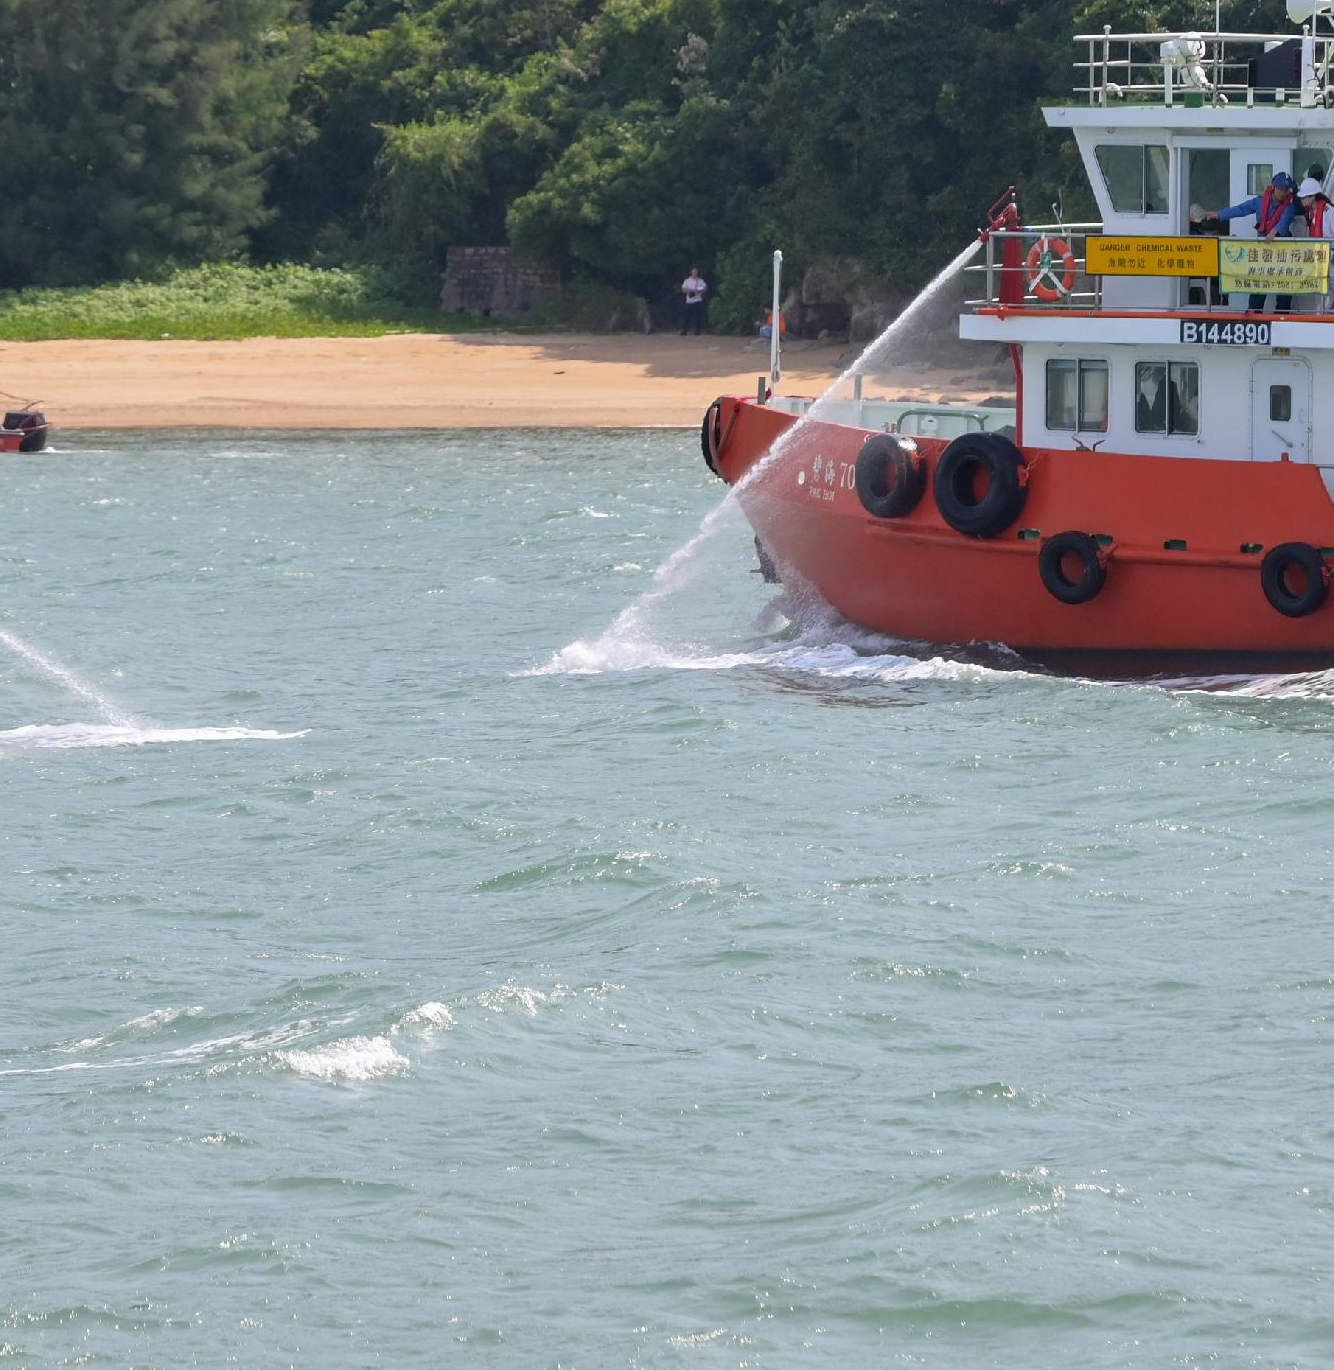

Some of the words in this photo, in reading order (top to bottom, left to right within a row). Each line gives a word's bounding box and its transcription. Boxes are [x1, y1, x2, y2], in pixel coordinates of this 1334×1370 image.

[1100, 243, 1131, 252] DANGER
[1136, 244, 1174, 253] CHEMICAL
[1177, 244, 1204, 253] WASTE
[1183, 322, 1269, 344] B144890
